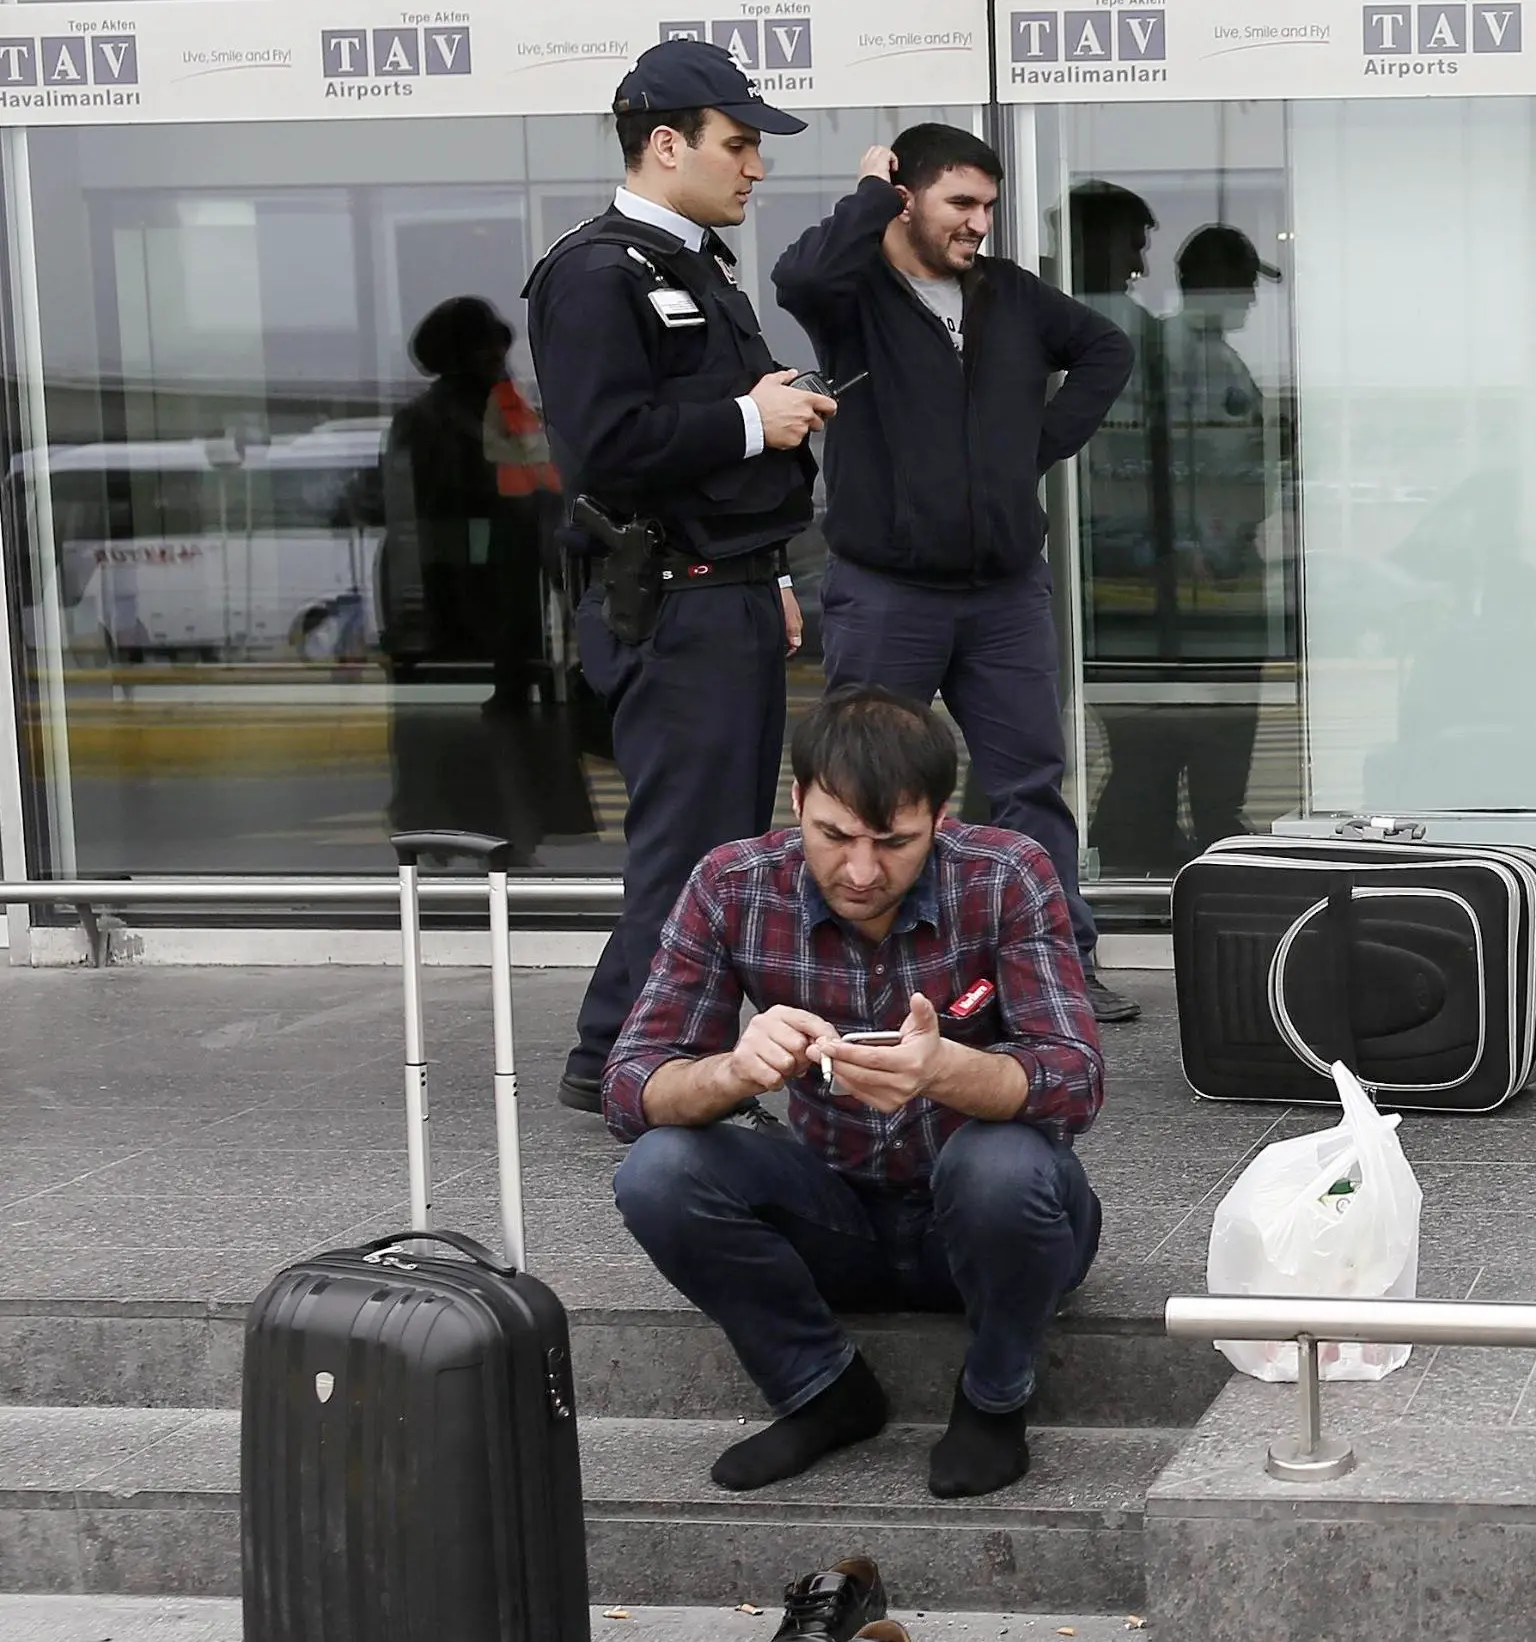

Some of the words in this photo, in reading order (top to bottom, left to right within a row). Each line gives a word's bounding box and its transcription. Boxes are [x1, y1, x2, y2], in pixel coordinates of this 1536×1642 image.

[740, 3, 771, 16] Tepe
[1019, 17, 1158, 57] TAV
[1214, 26, 1242, 40] Live,
[1245, 25, 1278, 39] Smile
[1281, 25, 1307, 38] and
[1310, 25, 1330, 40] Fly!
[1371, 11, 1513, 49] TAV
[546, 41, 579, 55] Smile
[581, 41, 606, 54] and
[858, 33, 886, 48] Live,
[888, 32, 922, 46] Smile
[924, 32, 950, 45] and
[953, 31, 973, 46] Fly!
[0, 43, 129, 81] TAV
[211, 49, 243, 63] Smile
[246, 48, 269, 62] and
[330, 34, 463, 73] TAV
[1011, 67, 1167, 84] Havalimanları
[1363, 59, 1459, 78] Airports
[324, 81, 413, 100] Airports
